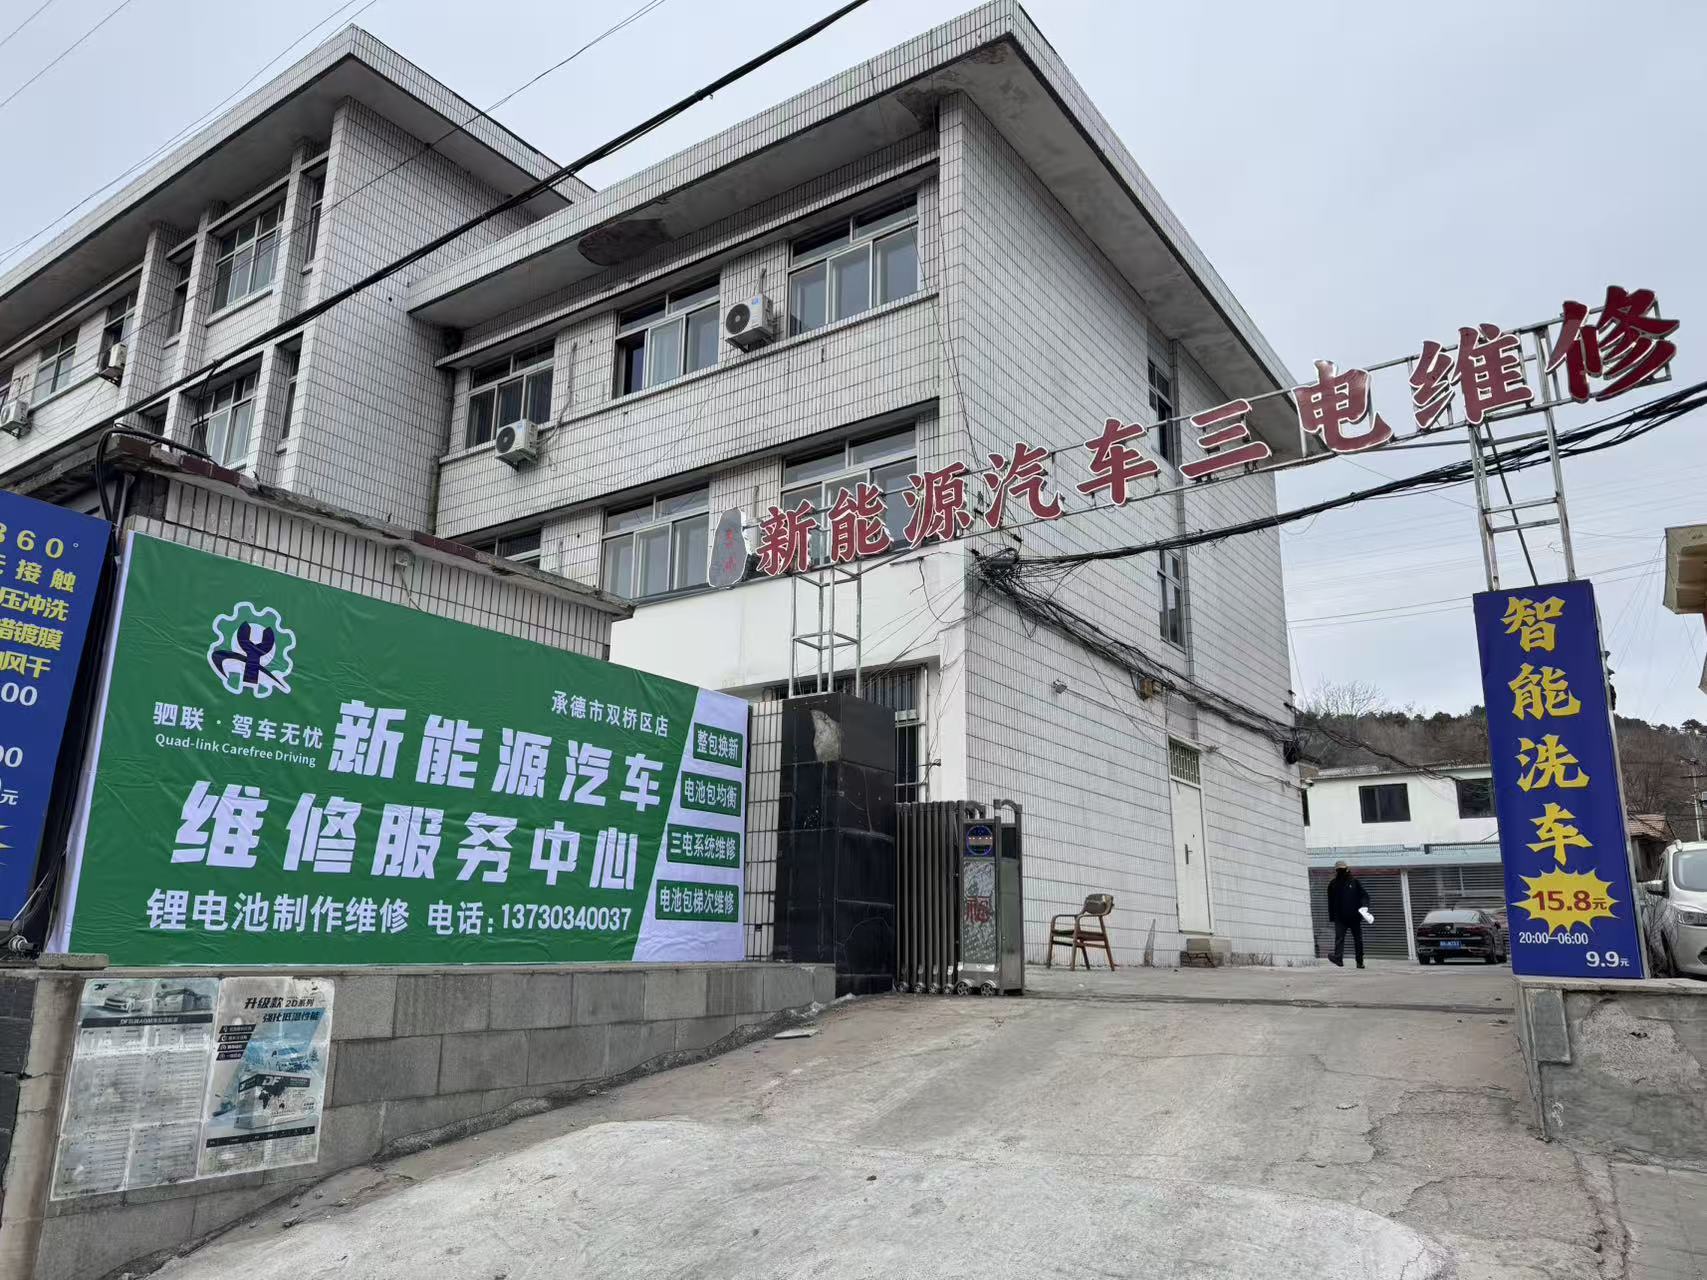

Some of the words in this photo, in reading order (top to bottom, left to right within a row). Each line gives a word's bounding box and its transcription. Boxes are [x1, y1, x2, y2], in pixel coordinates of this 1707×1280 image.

[756, 285, 1680, 577] 新能源汽车三电维修
[0, 554, 76, 592] 接触
[0, 651, 51, 678] 风干
[551, 690, 669, 738] 承德市双桥区店
[696, 729, 739, 761] 整包换新
[1501, 596, 1593, 867] 智能洗车
[0, 745, 23, 768] 0
[155, 733, 219, 752] Quad-link
[222, 742, 273, 760] Carefree
[275, 750, 316, 768] Driving
[328, 700, 664, 812] 新能源汽车
[684, 777, 737, 809] 电池包均衡
[170, 780, 638, 890] 维修服务中心
[670, 831, 736, 860] 三电系统维修
[146, 888, 409, 934] 锂电池制作维修
[660, 886, 735, 914] 电池包梯次维修
[1532, 890, 1607, 911] 15.8元
[1585, 951, 1630, 967] 9.9元
